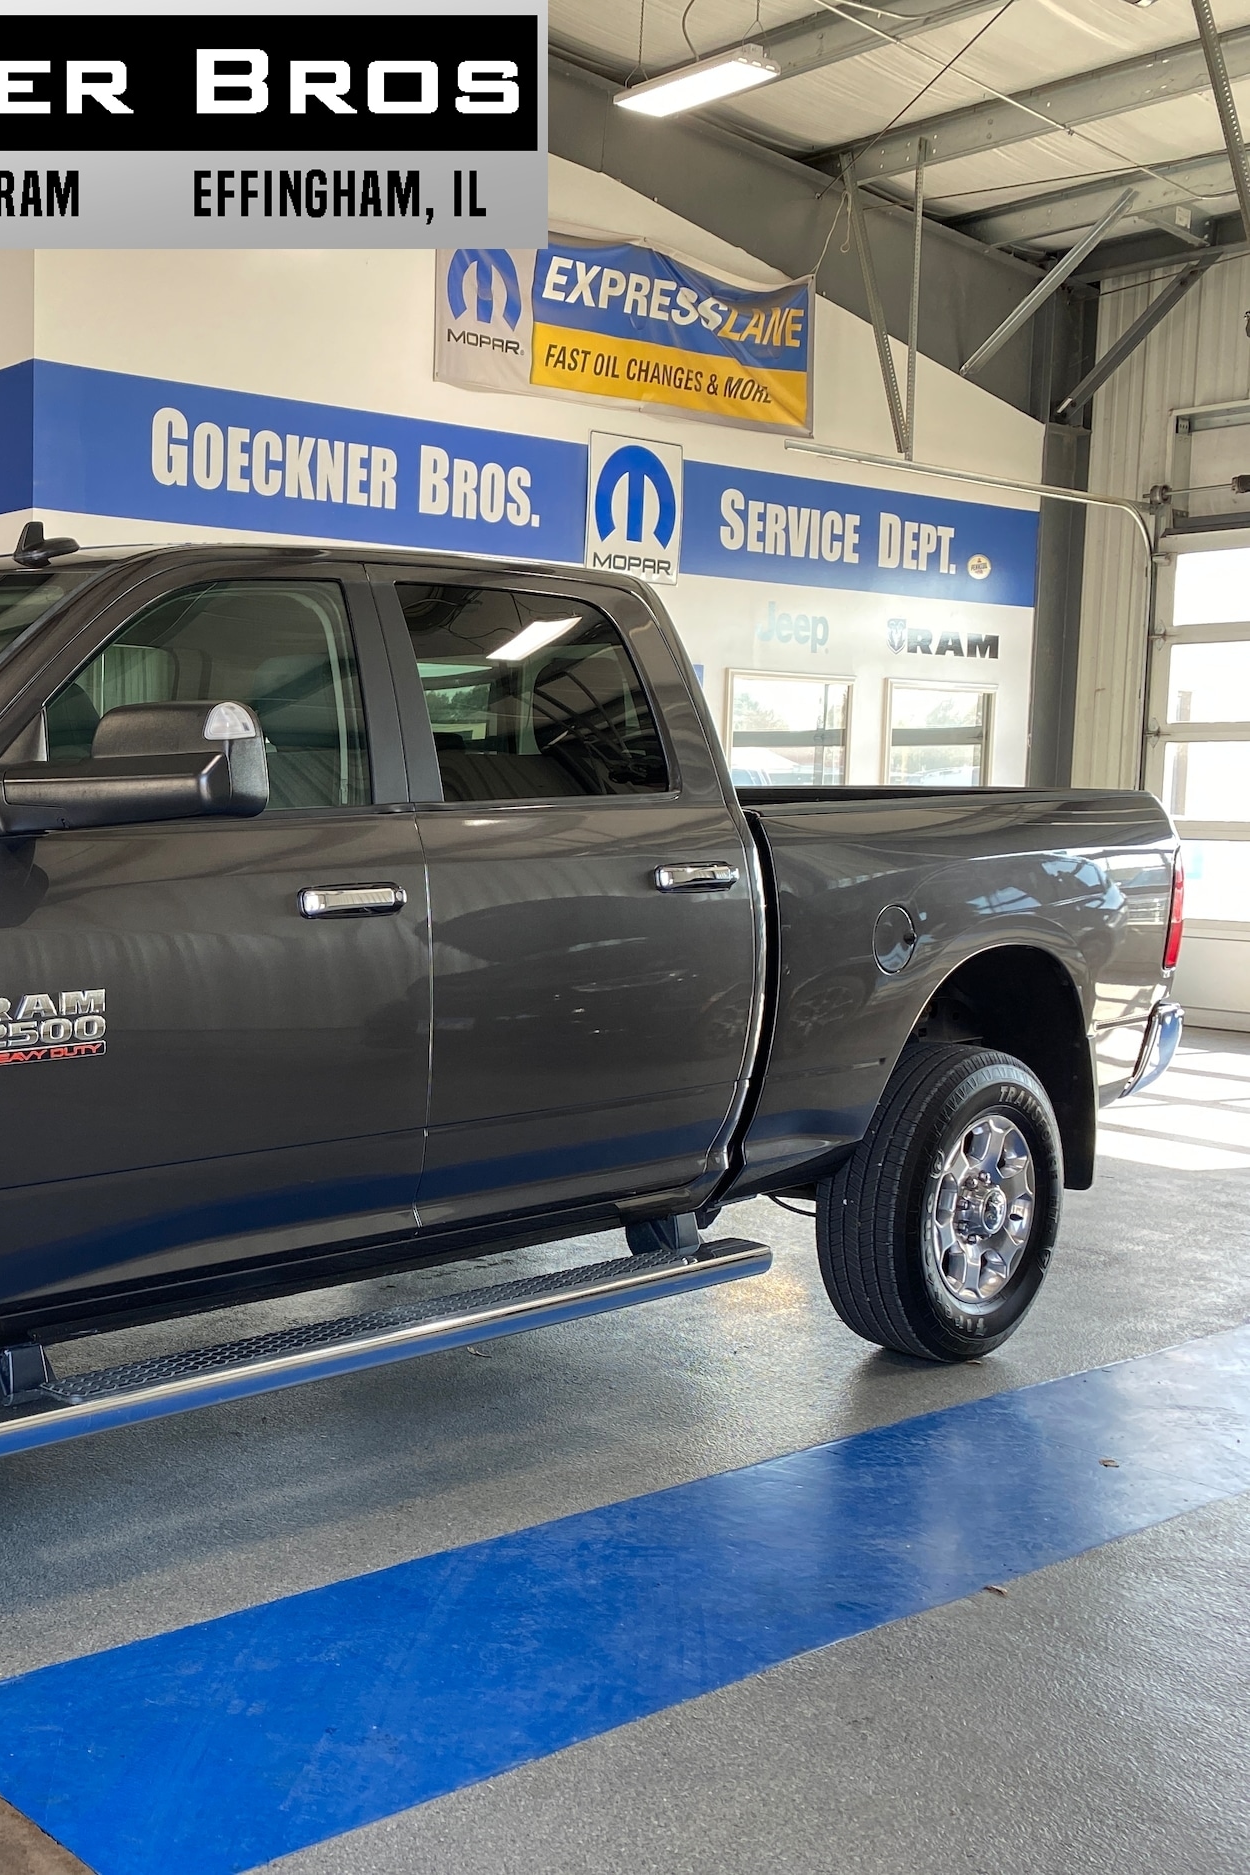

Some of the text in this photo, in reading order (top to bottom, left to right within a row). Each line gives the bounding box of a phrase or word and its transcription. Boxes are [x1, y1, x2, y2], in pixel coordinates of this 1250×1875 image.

[447, 328, 520, 356] MOPAR
[545, 343, 591, 372] FAST
[593, 352, 620, 378] OIL
[626, 358, 703, 392] CHANGES
[707, 373, 718, 397] &
[152, 407, 956, 575] GOECKNER BROS. SERVICE DEPT.
[593, 551, 671, 576] MOPAR
[757, 601, 829, 653] Jeep
[907, 628, 1000, 660] RAM
[50, 1043, 103, 1060] DUTY
